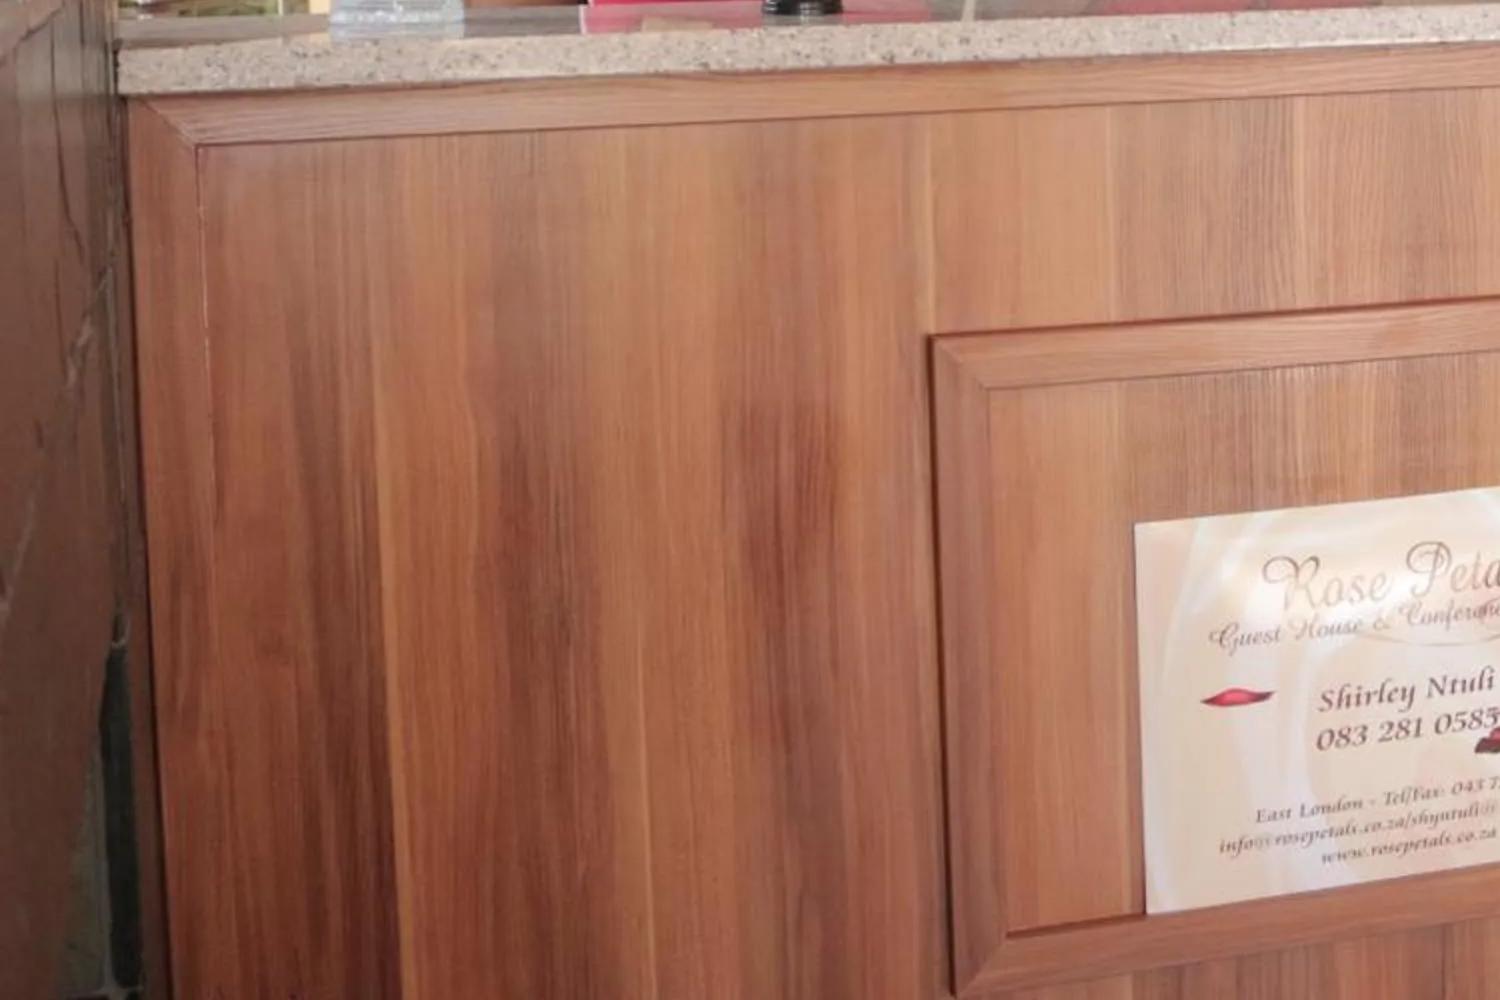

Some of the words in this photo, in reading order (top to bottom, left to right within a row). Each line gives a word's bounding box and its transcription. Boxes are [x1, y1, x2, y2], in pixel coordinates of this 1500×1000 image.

[1262, 555, 1388, 610] Rose
[1208, 621, 1281, 657] Guest
[1287, 612, 1364, 642] House
[1317, 677, 1417, 713] Shirley
[1426, 664, 1496, 699] Ntuli
[1315, 724, 1369, 751] 083
[1377, 716, 1424, 743] 281
[1433, 706, 1500, 736] 0585
[1254, 806, 1293, 824] East
[1298, 794, 1364, 818] London
[1451, 778, 1486, 796] 043
